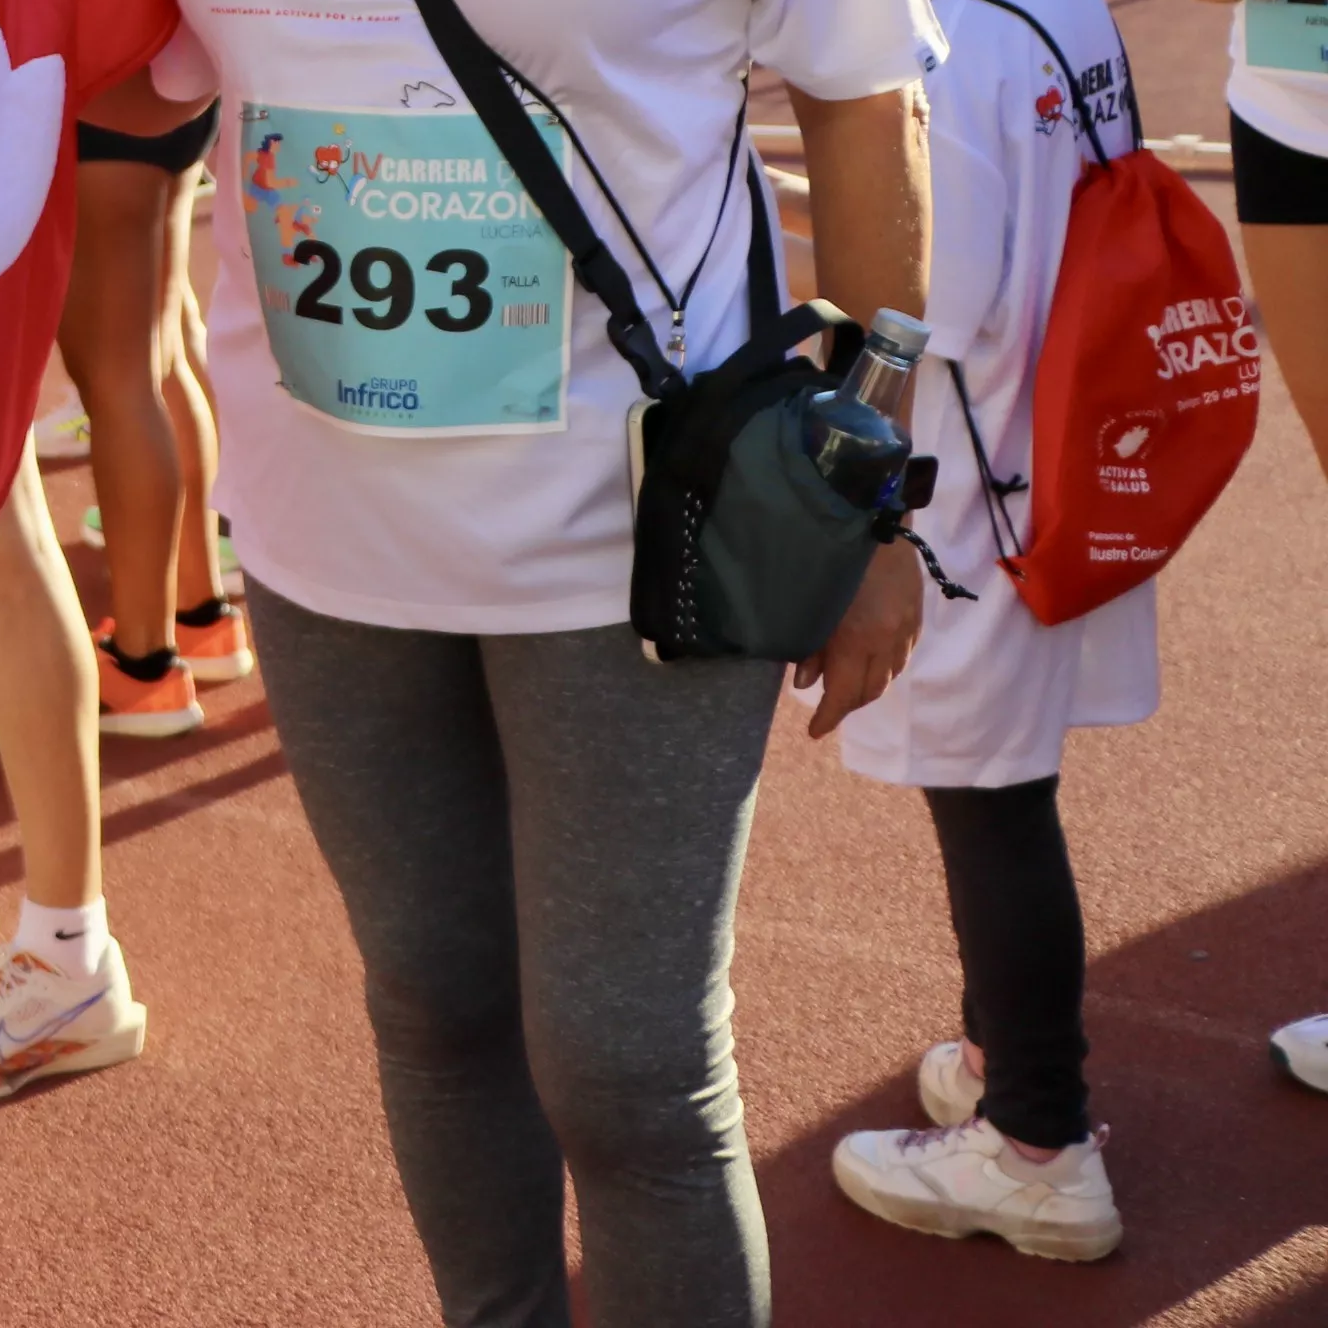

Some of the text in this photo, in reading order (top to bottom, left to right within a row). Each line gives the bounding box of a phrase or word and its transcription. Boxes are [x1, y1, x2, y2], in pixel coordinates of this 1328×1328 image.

[352, 152, 383, 180] IV
[380, 157, 488, 184] CARRERA
[479, 224, 543, 240] LUCENA
[294, 238, 494, 333] 293
[501, 274, 541, 288] TALLA
[370, 376, 418, 392] GRUPO
[338, 378, 420, 411] Infrico
[1110, 480, 1151, 494] SALUD
[1089, 546, 1129, 561] Ilustre
